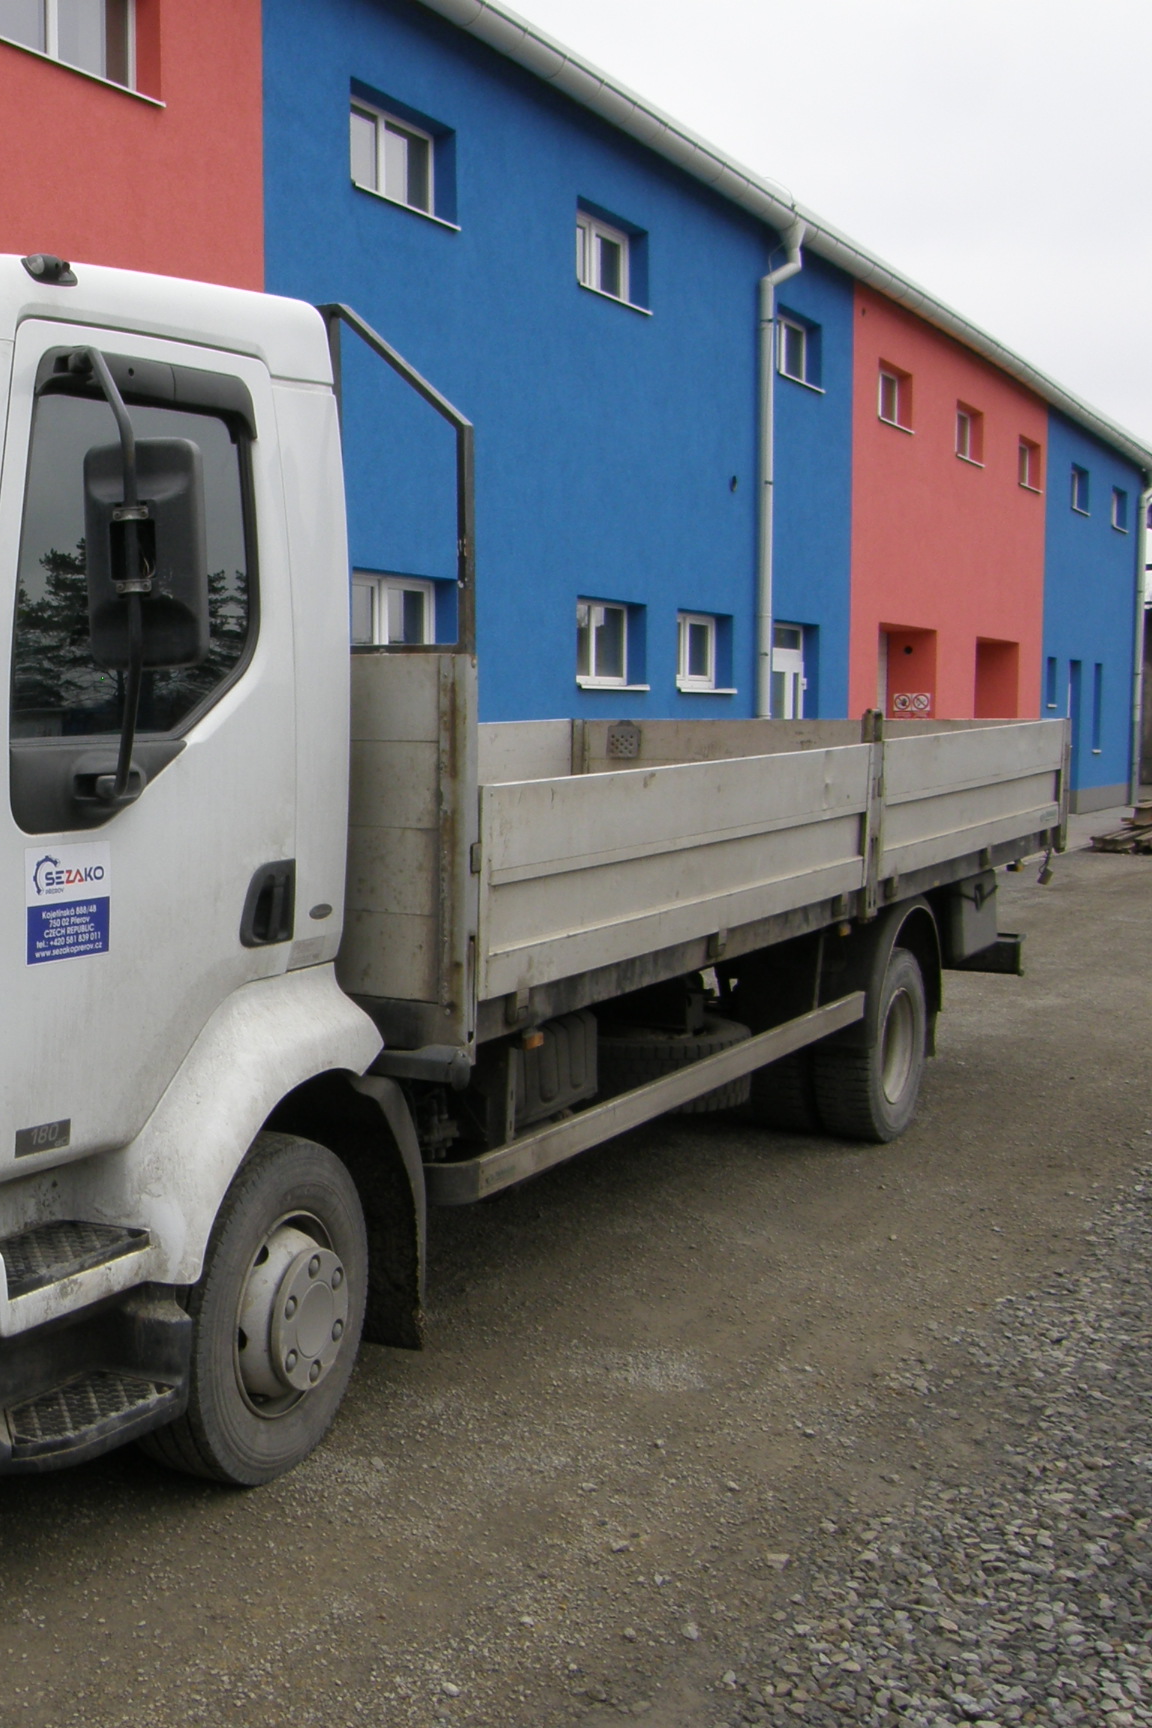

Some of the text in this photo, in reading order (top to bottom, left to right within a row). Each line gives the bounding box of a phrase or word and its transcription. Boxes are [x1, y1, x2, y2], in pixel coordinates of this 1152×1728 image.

[45, 866, 104, 887] SEZAKO
[44, 923, 95, 938] CZECH REPUBLIC
[49, 919, 61, 928] 750
[61, 918, 69, 927] 02
[50, 938, 65, 946] +420
[90, 931, 101, 940] 011
[31, 1123, 59, 1146] 180
